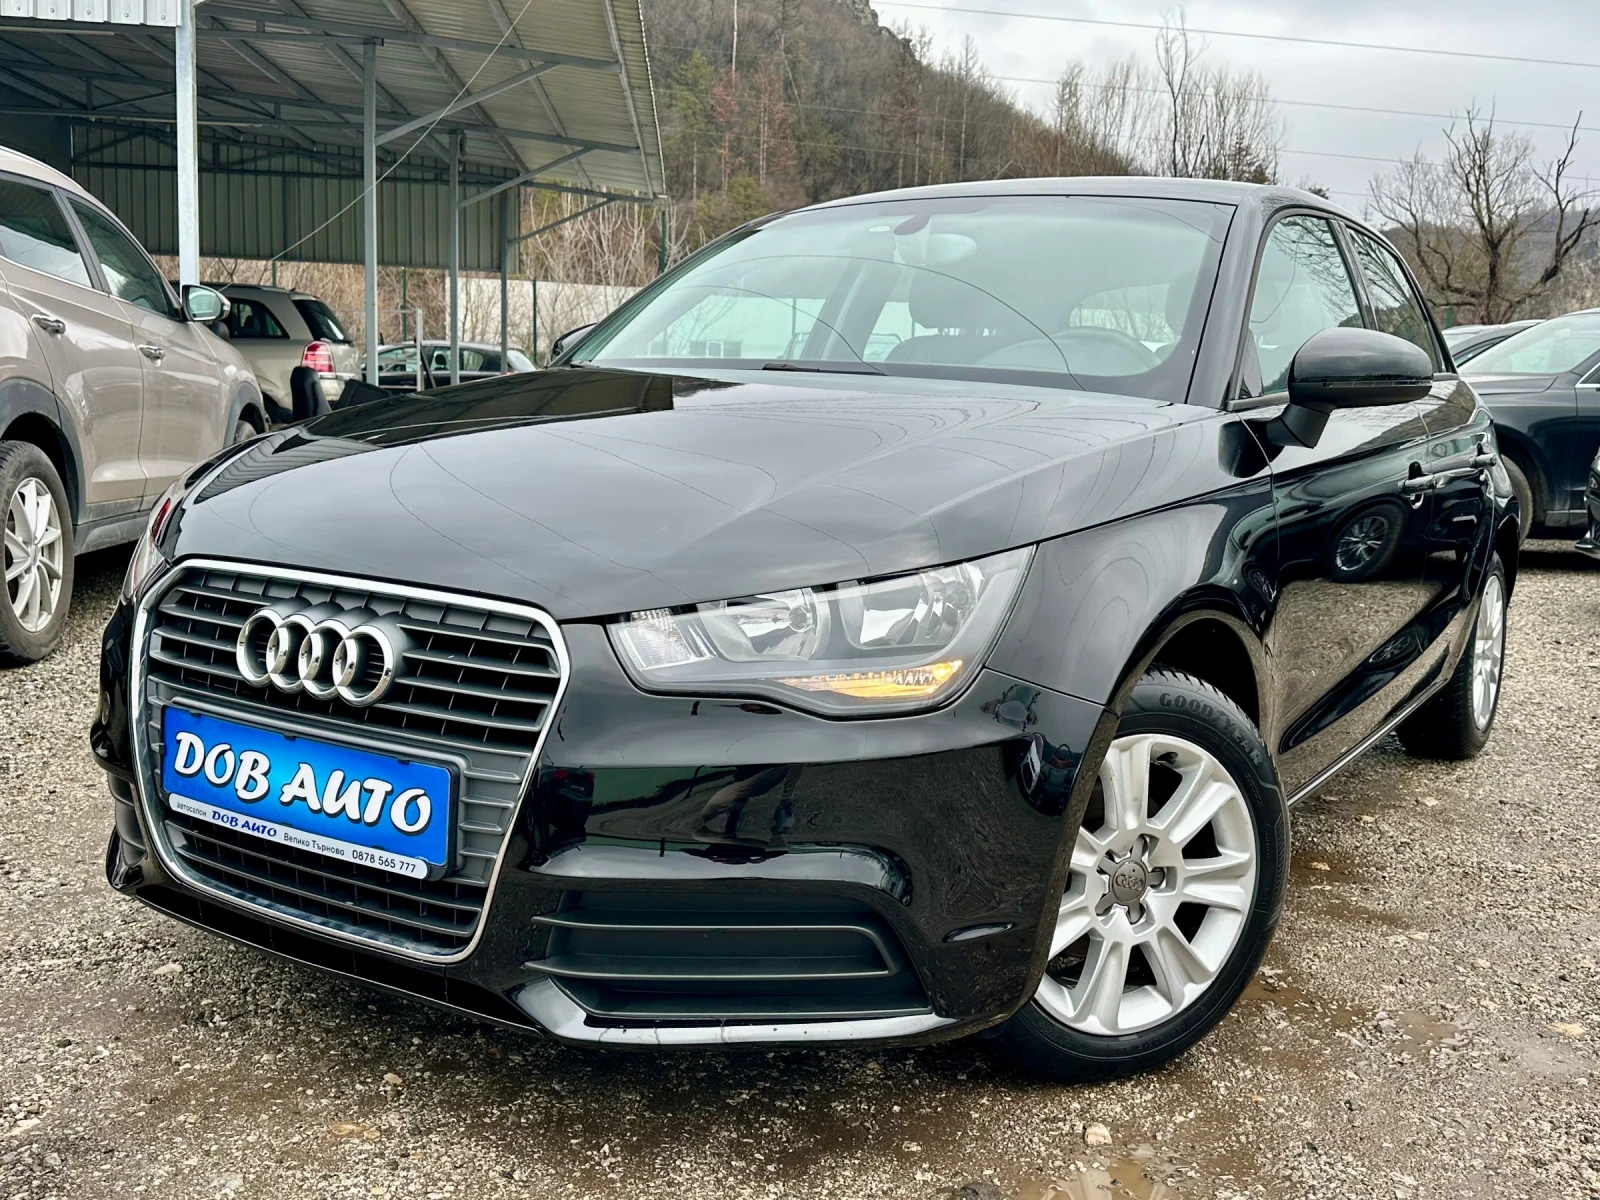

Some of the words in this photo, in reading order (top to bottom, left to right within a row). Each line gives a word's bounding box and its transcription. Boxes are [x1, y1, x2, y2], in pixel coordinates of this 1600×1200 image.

[1159, 692, 1263, 766] GOODYEAR
[174, 731, 271, 803] DOB
[279, 762, 432, 835] AUTO
[176, 801, 207, 817] автосалон
[211, 810, 239, 827] DOB
[241, 820, 277, 837] AUTO
[283, 832, 310, 848] Велико
[311, 840, 345, 857] Търново
[352, 850, 376, 864] 0878
[378, 855, 396, 869] 565
[399, 860, 416, 874] 777
